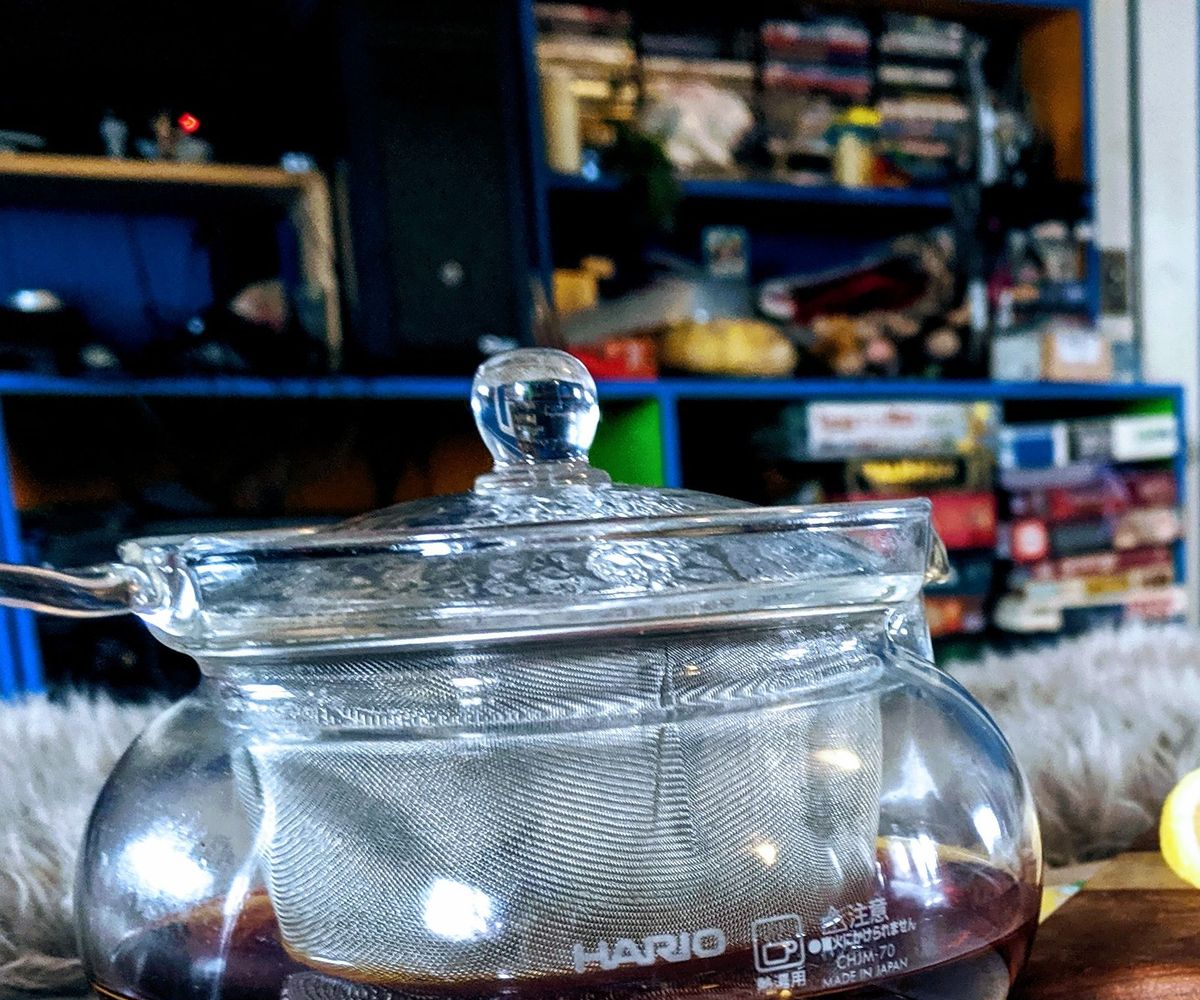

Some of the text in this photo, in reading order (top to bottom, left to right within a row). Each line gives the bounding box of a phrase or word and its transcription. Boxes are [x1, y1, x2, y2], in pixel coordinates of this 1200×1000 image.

[847, 897, 890, 928] 注意
[573, 928, 727, 974] HARIO
[823, 957, 909, 988] MADE IN JAPAN
